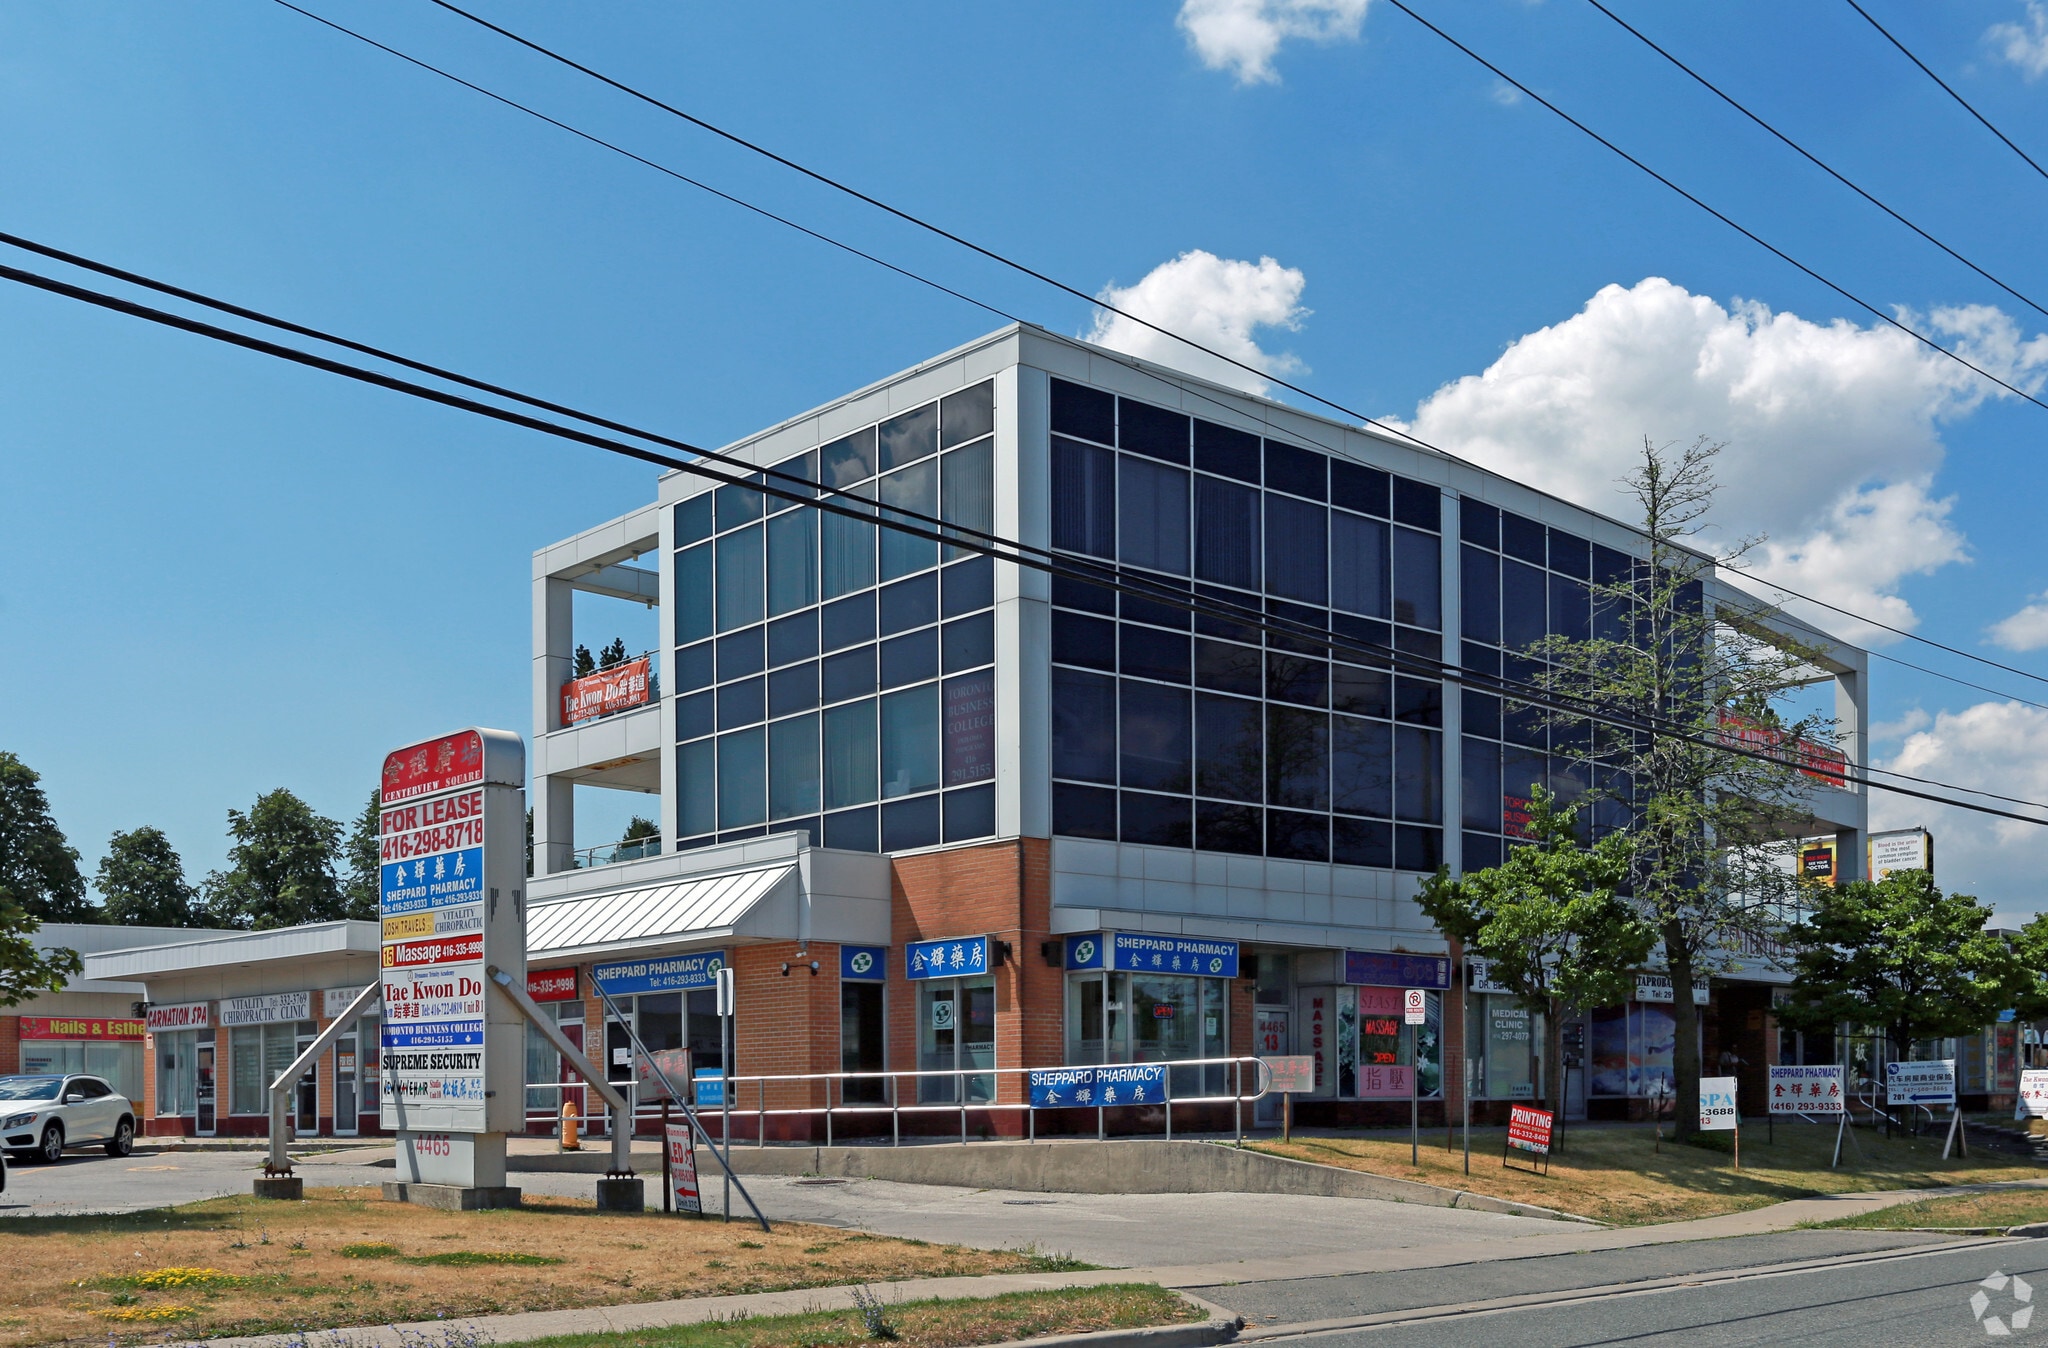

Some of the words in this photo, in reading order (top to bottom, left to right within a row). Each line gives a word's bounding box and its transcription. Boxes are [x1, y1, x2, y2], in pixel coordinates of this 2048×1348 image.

[564, 695, 579, 713] Tae
[580, 690, 602, 708] Kwon
[604, 683, 618, 701] Do
[385, 780, 440, 801] CENTERVIEW
[445, 769, 480, 787] SQUARE
[382, 807, 417, 834] FOR
[423, 792, 482, 827] LEASE
[382, 818, 483, 861] 416-298-8718
[1898, 850, 1918, 860] symptom
[386, 886, 427, 902] SHEPPARD
[430, 877, 476, 896] PHARMACY
[391, 899, 427, 913] 416-293-9333
[431, 897, 443, 907] Fax:
[443, 908, 475, 920] VITALITY
[384, 920, 399, 936] JOSH
[401, 918, 426, 933] TRAVELS
[435, 916, 483, 933] CHIROPRACTIC
[384, 949, 393, 965] 15
[396, 944, 442, 963] Massage
[1117, 937, 1174, 951] SHEPPARD
[1176, 940, 1234, 956] PHARMACY
[911, 942, 984, 972] 金輝藥房
[1129, 952, 1200, 972] 金輝藥房
[597, 966, 647, 981] SHEPPARD
[649, 958, 705, 975] PHARMACY
[650, 977, 661, 987] Tel:
[663, 973, 706, 986] 416-293-9333
[384, 984, 408, 1001] Tae
[413, 981, 453, 1000] Kwon
[458, 978, 482, 996] Do
[1652, 990, 1662, 998] Tel:
[231, 997, 265, 1010] VITALITY
[279, 993, 307, 1006] 332-3769
[147, 1008, 190, 1028] CARNATION
[191, 1006, 207, 1025] SPA
[223, 1007, 276, 1024] CHIROPRACTIC
[281, 1004, 305, 1020] CLINIC
[1155, 1006, 1172, 1016] OPEN
[1492, 1009, 1529, 1018] MEDICAL
[50, 1020, 87, 1034] Nails
[92, 1023, 102, 1034] &
[383, 1025, 414, 1036] TORONTO
[415, 1024, 449, 1035] BUSINESS
[450, 1022, 483, 1033] COLLEGE
[1260, 1021, 1285, 1033] 4465
[1365, 1019, 1398, 1035] MASSAGE
[1495, 1021, 1523, 1029] CLINIC
[411, 1035, 453, 1044] 416-291-5155
[1264, 1034, 1279, 1051] 13
[1312, 998, 1324, 1086] MASSAGE
[1501, 1032, 1529, 1040] 297-4077
[383, 1054, 428, 1070] SUPREME
[430, 1053, 481, 1070] SECURITY
[1374, 1052, 1396, 1063] OPEN
[1031, 1070, 1093, 1087] SHEPPARD
[1096, 1067, 1161, 1083] PHARMACY
[1771, 1068, 1804, 1078] SHEPPARD
[1805, 1067, 1841, 1078] PHARMACY
[1045, 1085, 1146, 1104] 金輝藥房
[1773, 1082, 1840, 1098] 金輝藥房
[1700, 1093, 1734, 1107] SPA
[1771, 1102, 1795, 1111] (416)
[1797, 1102, 1842, 1111] 293-9333
[1511, 1108, 1552, 1128] PRINTING
[666, 1127, 688, 1139] Running
[416, 1134, 450, 1156] 4465
[669, 1142, 684, 1164] LED
